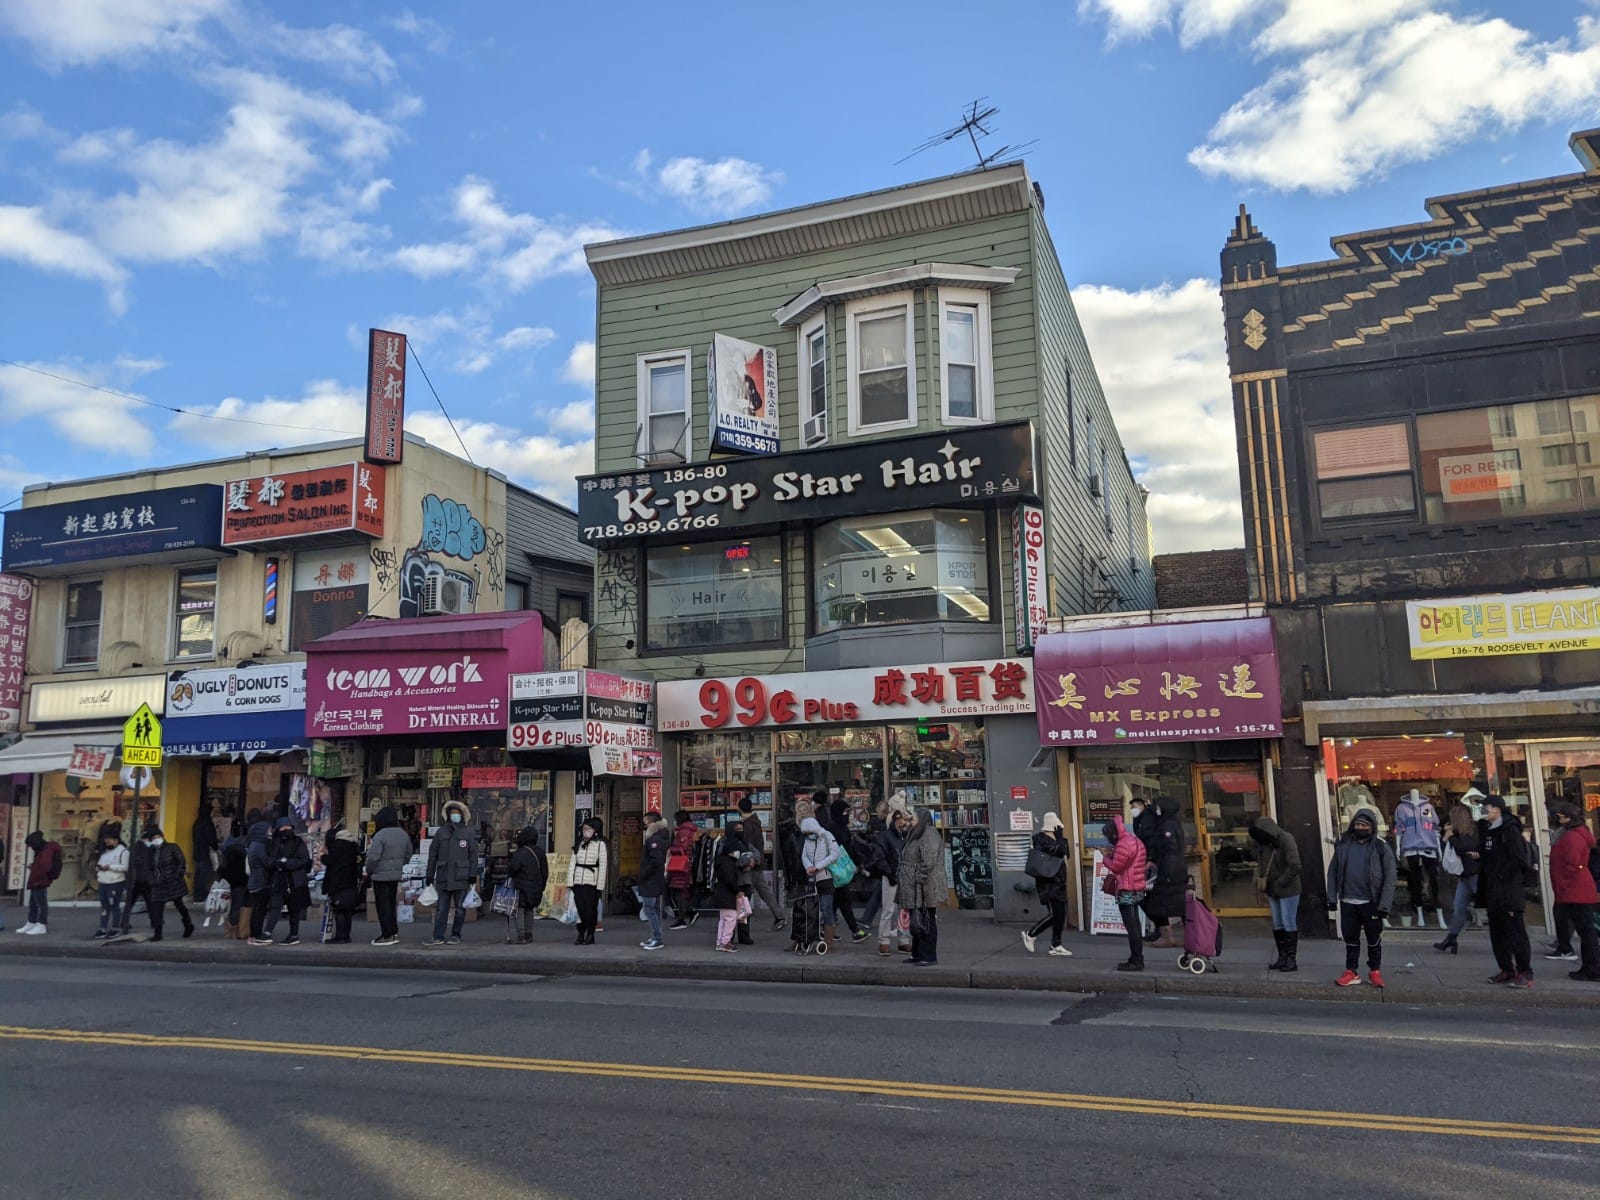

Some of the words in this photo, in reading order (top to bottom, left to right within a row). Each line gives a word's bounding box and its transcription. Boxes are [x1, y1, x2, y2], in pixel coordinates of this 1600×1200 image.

[734, 415, 759, 433] REALTY
[735, 433, 778, 453] 359-5678
[663, 464, 728, 484] 136-80
[1443, 463, 1473, 476] FOR
[1478, 459, 1516, 472] RENT
[614, 479, 759, 522] K-pop
[773, 471, 863, 501] Star
[880, 455, 981, 488] Hair
[960, 479, 1020, 498] 미용실
[584, 513, 720, 540] 718.939.6766
[726, 548, 749, 559] OPEN
[692, 590, 727, 605] Hair
[1420, 603, 1507, 639] 아이랜드
[1451, 646, 1485, 655] 136-76
[1487, 642, 1544, 653] ROOSEVELT
[1548, 638, 1589, 649] AVENUE
[326, 667, 391, 692] team
[397, 655, 484, 686] work
[196, 680, 228, 694] UGLY
[237, 675, 289, 692] DONUTS
[350, 689, 393, 699] Handbags
[394, 687, 402, 696] &
[404, 685, 457, 696] Accessories
[871, 661, 1028, 706] 成功百货
[226, 698, 232, 706] &
[234, 697, 257, 706] CORN
[258, 695, 281, 704] DOGS
[940, 704, 978, 715] Success
[980, 703, 1015, 713] Trading
[1015, 702, 1031, 711] Inc
[514, 706, 540, 717] K-pop
[542, 704, 560, 713] Star
[561, 702, 581, 711] Hair
[590, 702, 613, 719] K-pop
[614, 705, 629, 718] Star
[629, 707, 645, 719] Hair
[803, 698, 860, 722] Plus
[1089, 710, 1121, 723] MX
[1130, 707, 1222, 722] Express
[322, 722, 349, 732] Korean
[349, 721, 384, 731] Clothings
[408, 714, 427, 729] Dr
[430, 712, 499, 728] MINERAL
[662, 719, 691, 729] 136-80
[1234, 723, 1276, 734] 136-78
[512, 723, 553, 748] 99¢
[555, 731, 583, 745] Plus
[610, 731, 626, 745] Plus
[1128, 726, 1221, 738] meixinexpress1
[241, 740, 267, 750] FOOD
[126, 748, 157, 763] AHEAD
